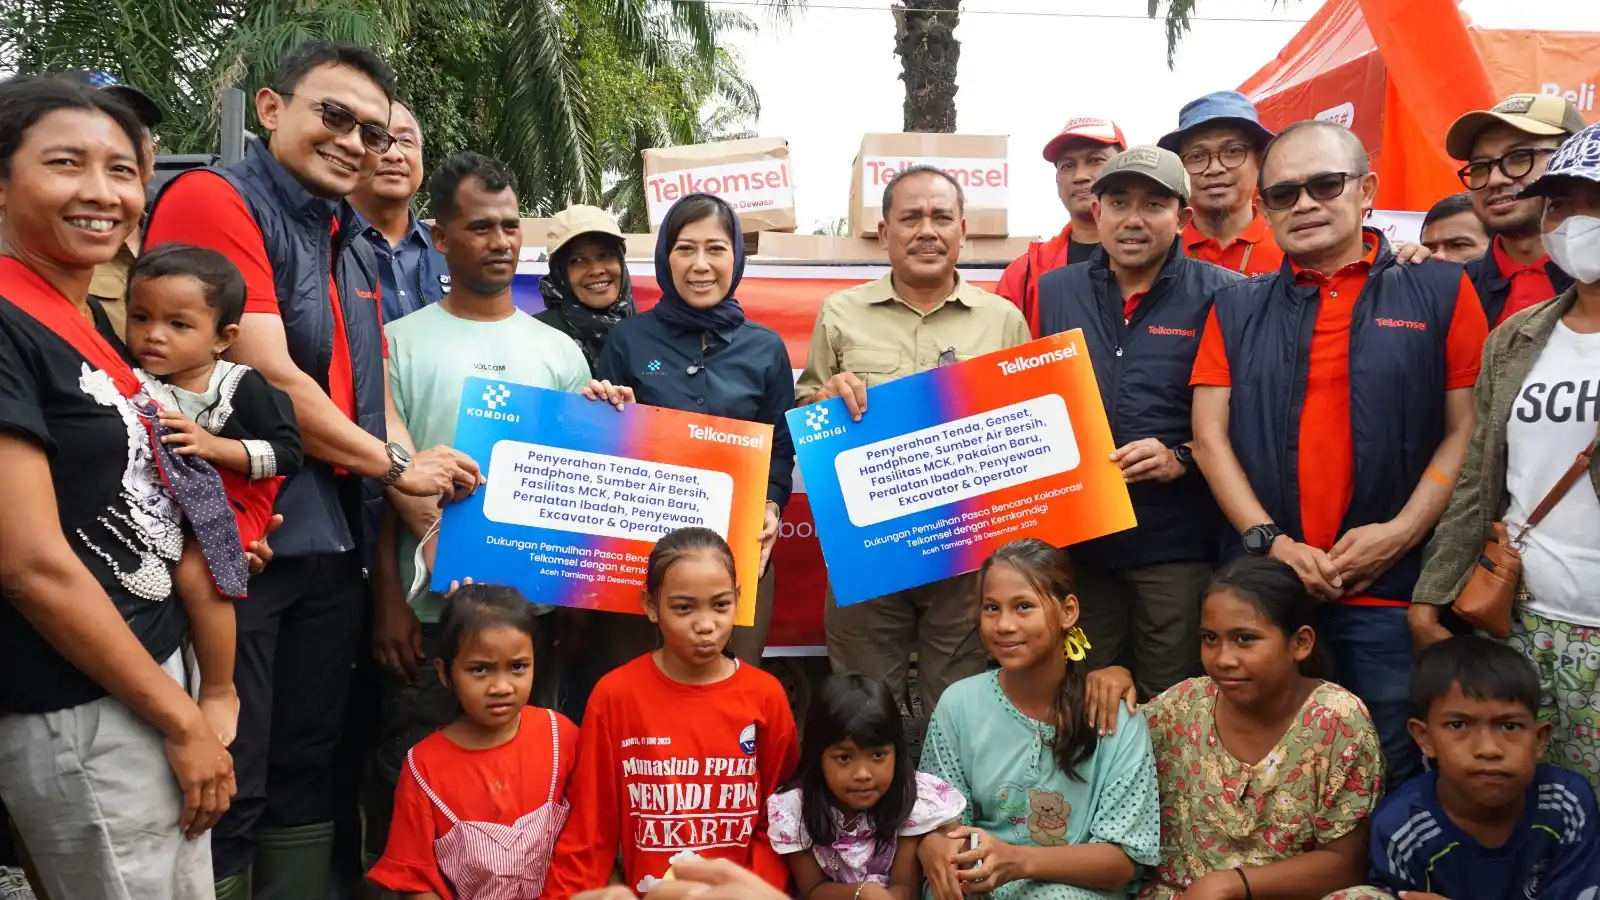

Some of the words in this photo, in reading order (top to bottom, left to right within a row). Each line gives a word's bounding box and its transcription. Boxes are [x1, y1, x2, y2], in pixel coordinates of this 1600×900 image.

[648, 163, 790, 203] Telkomsel
[866, 161, 1009, 188] Temsel
[740, 199, 774, 210] Dewasa
[1148, 325, 1196, 338] Telkomsel
[1375, 317, 1427, 331] Telkomsel
[474, 363, 506, 372] VOLCOM
[997, 343, 1078, 376] Telkomsel
[466, 408, 520, 423] KOMDIGI
[688, 424, 764, 449] Telkomsel
[798, 426, 847, 445] KOMDIGI
[859, 451, 933, 476] Handphone,
[934, 436, 982, 455] Sumber
[986, 429, 1002, 441] Air
[1004, 418, 1047, 436] Bersih,
[866, 434, 940, 460] Penyerahan
[941, 422, 984, 439] Tenda,
[985, 408, 1032, 427] Genset,
[527, 450, 606, 471] Penyerahan
[609, 462, 651, 479] Tenda,
[654, 469, 700, 485] Genset,
[868, 478, 929, 501] Peralatan
[930, 464, 977, 484] Ibadah,
[978, 445, 1051, 470] Penyewaan
[870, 466, 922, 487] Fasilitas
[923, 456, 955, 472] MCK,
[956, 443, 1007, 463] Pakaian
[1009, 434, 1042, 449] Baru,
[514, 462, 592, 484] Handphone,
[596, 474, 646, 490] Sumber
[648, 479, 667, 493] Air
[668, 485, 709, 500] Bersih,
[520, 477, 575, 494] Fasilitas
[578, 485, 610, 500] MCK,
[613, 490, 664, 506] Pakaian
[667, 498, 699, 512] Baru,
[898, 483, 959, 506] Excavator
[962, 479, 972, 489] &
[973, 464, 1028, 487] Operator
[512, 490, 577, 508] Peralatan
[579, 499, 628, 516] Ibadah,
[631, 506, 703, 525] Penyewaan
[539, 508, 605, 525] Excavator
[607, 517, 616, 527] &
[863, 530, 910, 547] Dukungan
[912, 516, 961, 534] Pemulihan
[961, 508, 990, 521] Pasca
[991, 497, 1033, 513] Bencana
[1033, 483, 1083, 501] Kolaborasi
[906, 528, 952, 547] Telkomsel
[953, 520, 990, 535] dengan
[990, 504, 1048, 525] Kemkomdigi
[922, 546, 940, 555] Aceh
[940, 538, 973, 550] Tamiang,
[973, 533, 983, 541] 28
[983, 525, 1018, 539] Desember
[1020, 519, 1037, 528] 2025
[486, 535, 538, 550] Dukungan
[539, 542, 592, 557] Pemulihan
[593, 548, 623, 560] Pasca
[625, 552, 649, 563] Benc
[529, 552, 578, 567] Telkomsel
[579, 559, 618, 572] dengan
[539, 568, 559, 576] Aceh
[561, 570, 595, 582] Tamiang,
[596, 574, 606, 582] 28
[622, 757, 700, 777] Munaslub
[627, 783, 712, 814] MENJADI
[635, 817, 753, 847] JAKARTA
